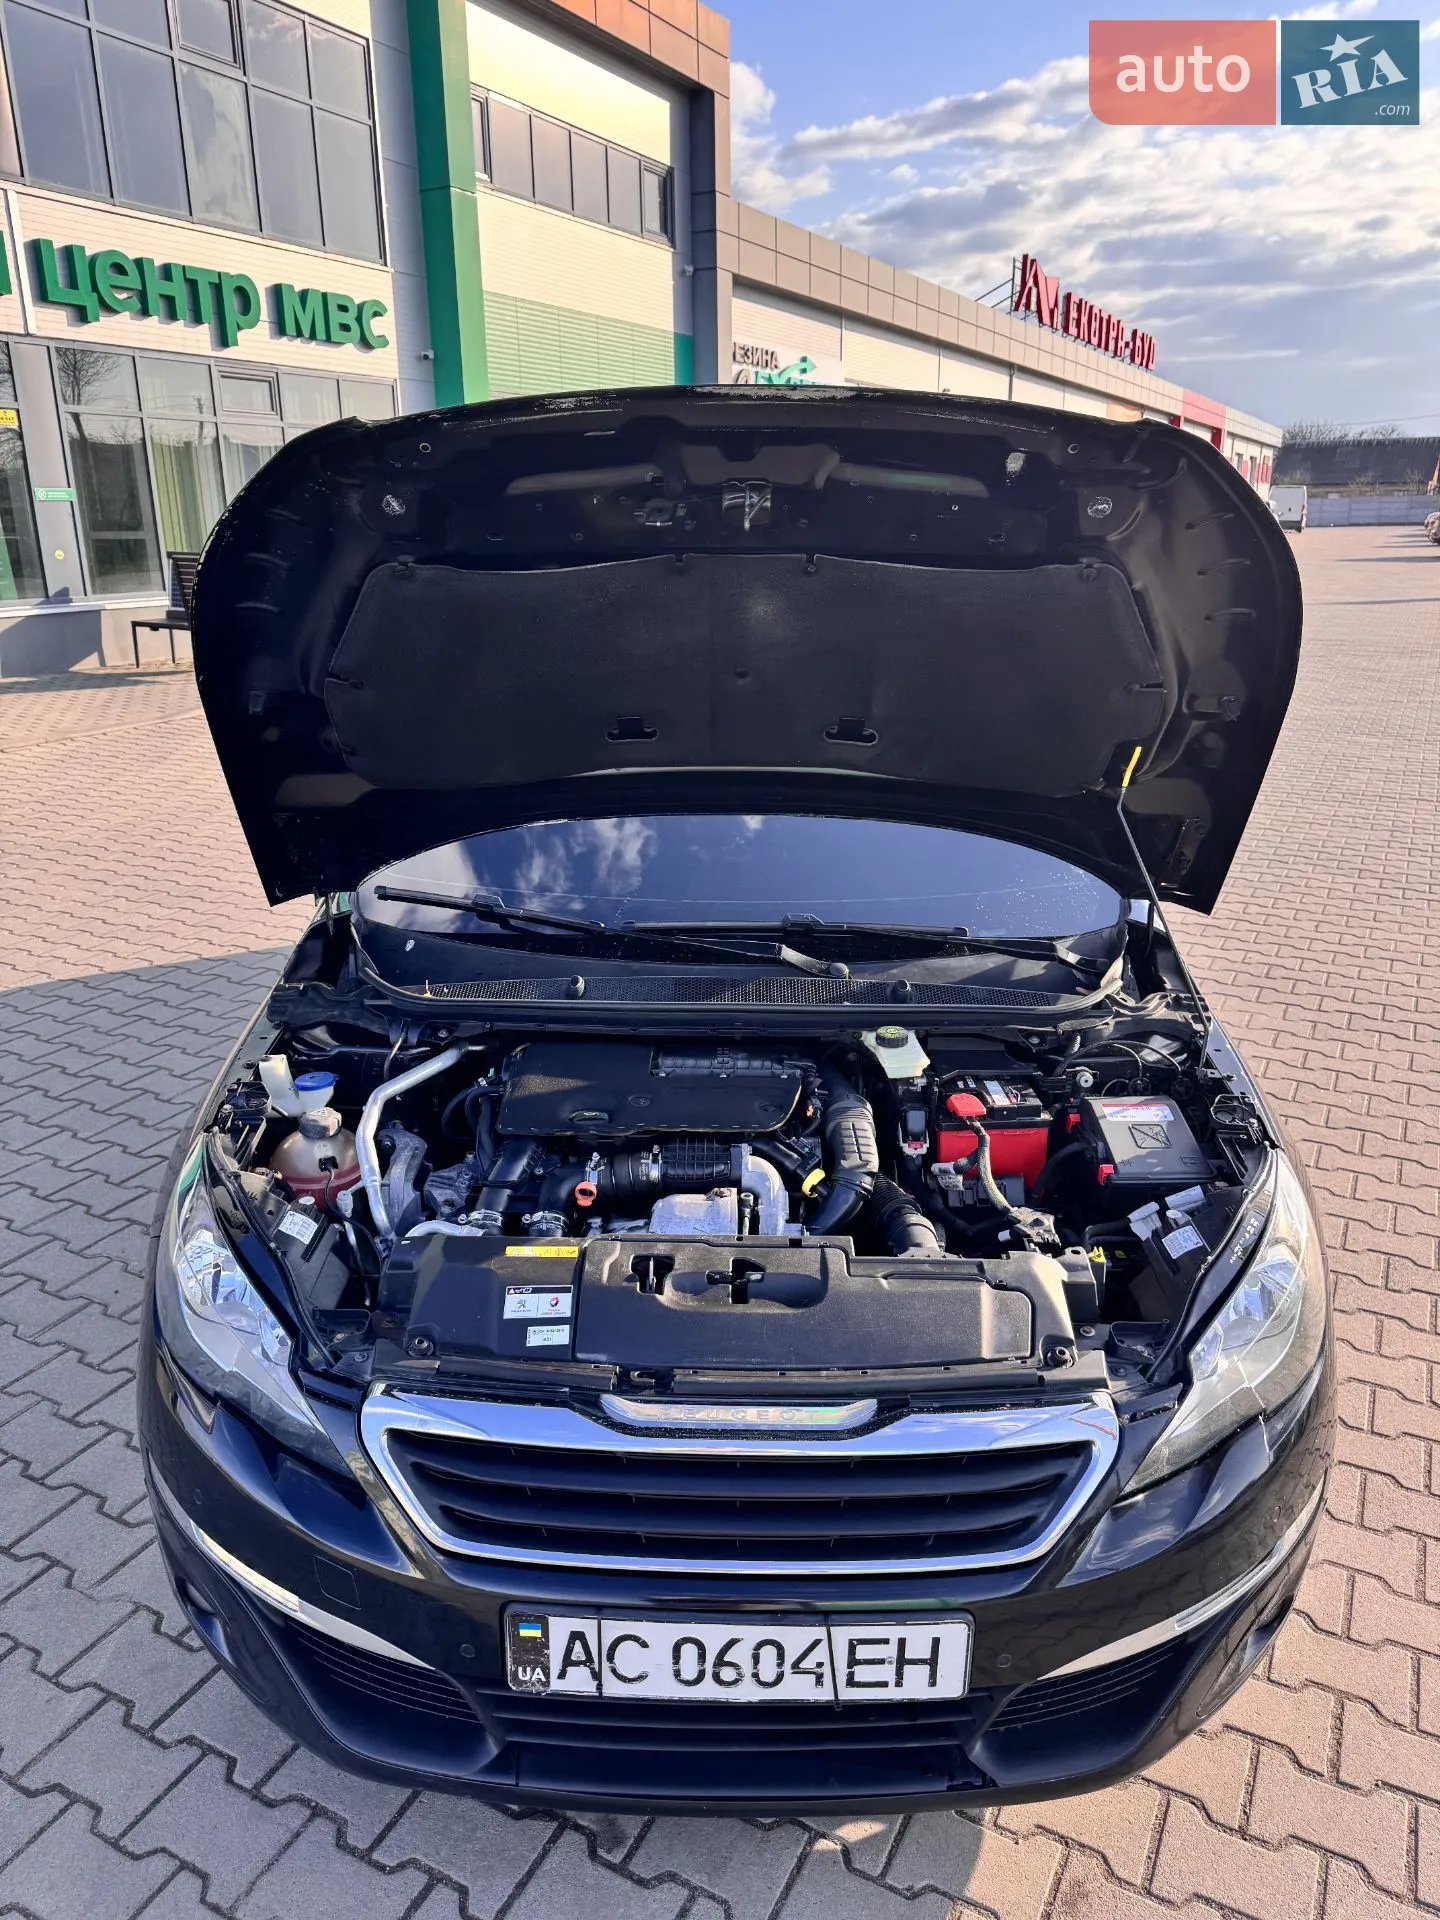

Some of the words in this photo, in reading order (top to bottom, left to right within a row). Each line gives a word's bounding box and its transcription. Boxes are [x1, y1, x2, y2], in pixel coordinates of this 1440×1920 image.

[517, 1665, 547, 1683] UA
[557, 1630, 651, 1685] AC
[672, 1636, 825, 1688] 0604
[845, 1636, 939, 1688] EH
